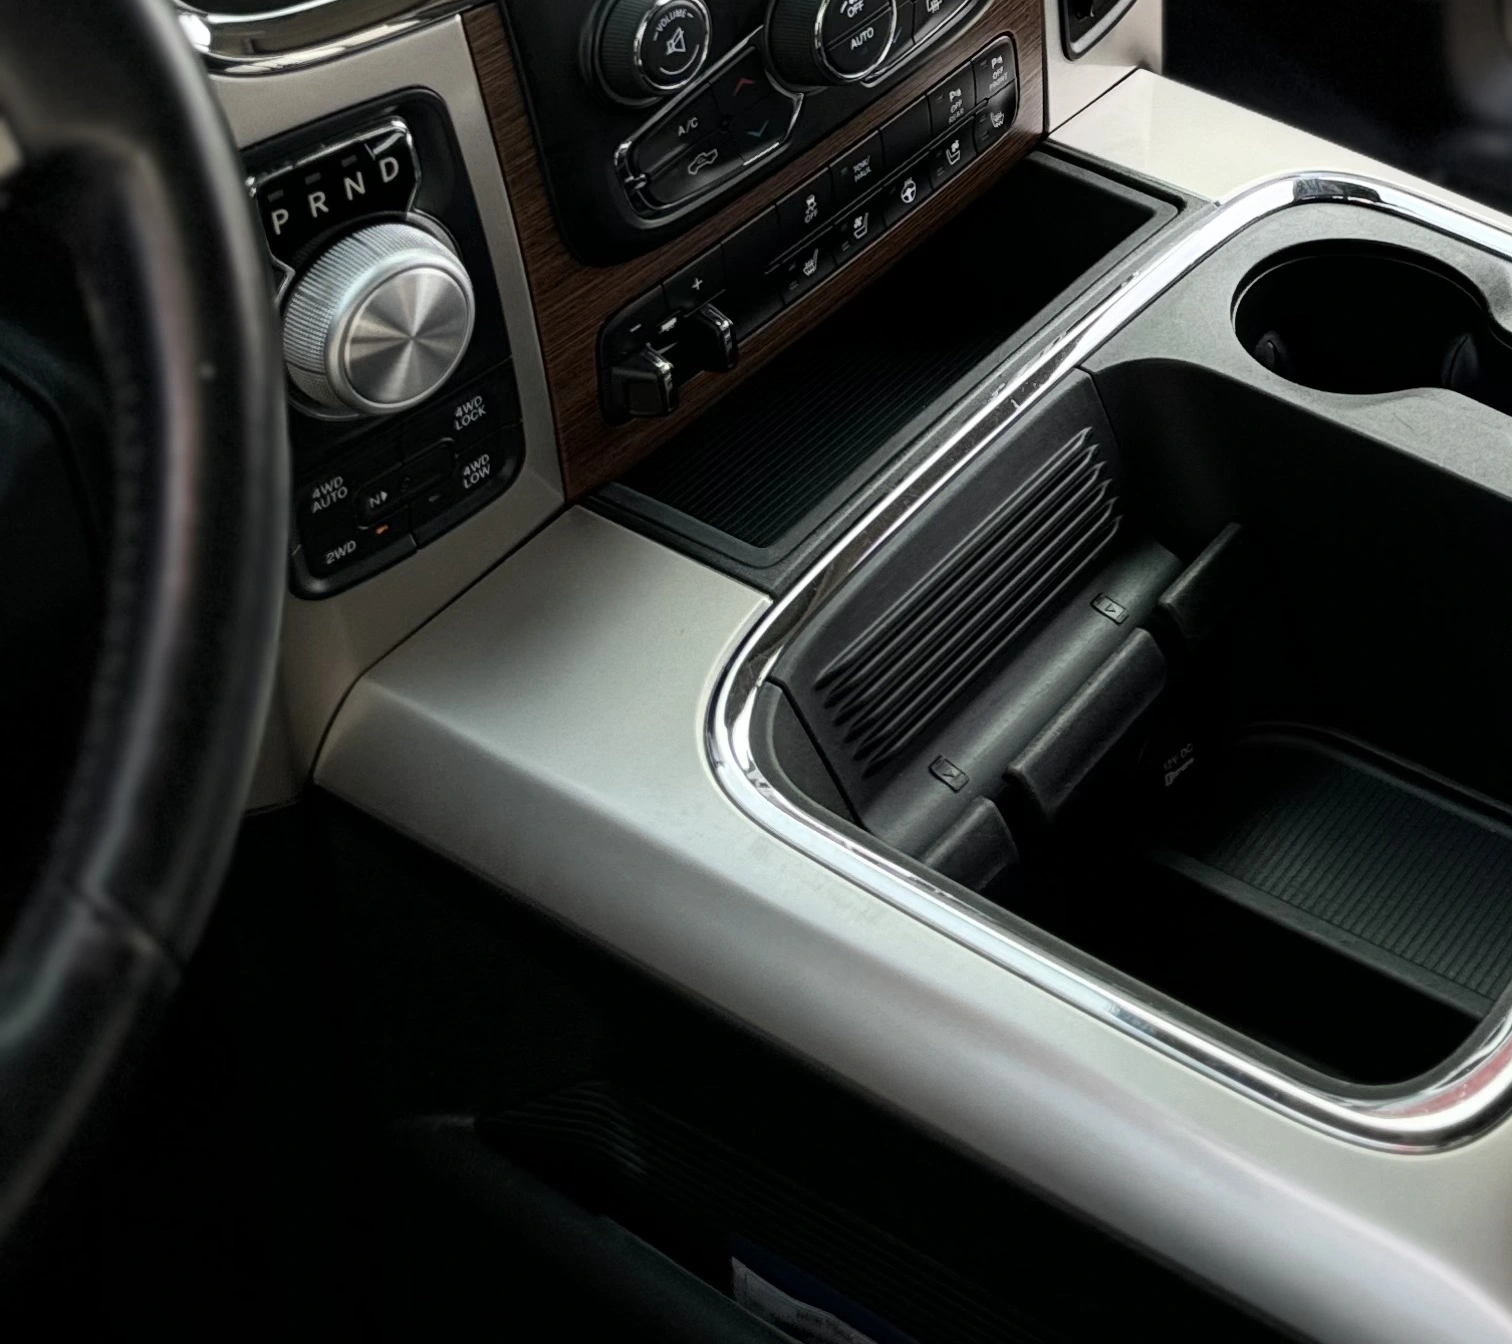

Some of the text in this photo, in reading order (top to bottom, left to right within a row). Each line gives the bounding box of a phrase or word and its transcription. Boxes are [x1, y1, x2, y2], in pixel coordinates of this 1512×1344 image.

[656, 8, 687, 32] VOLUME
[847, 0, 865, 18] OFF
[850, 26, 875, 50] AUTO
[678, 116, 699, 137] A/C
[271, 156, 400, 235] P R N D
[804, 209, 818, 224] OFF
[455, 395, 483, 417] 4WD
[455, 404, 487, 431] LOCK
[463, 454, 490, 476] 4WD
[463, 464, 491, 489] LOW
[312, 476, 344, 499] 4WD
[312, 486, 348, 514] AUTO
[369, 494, 381, 508] N
[326, 540, 357, 565] 2WD
